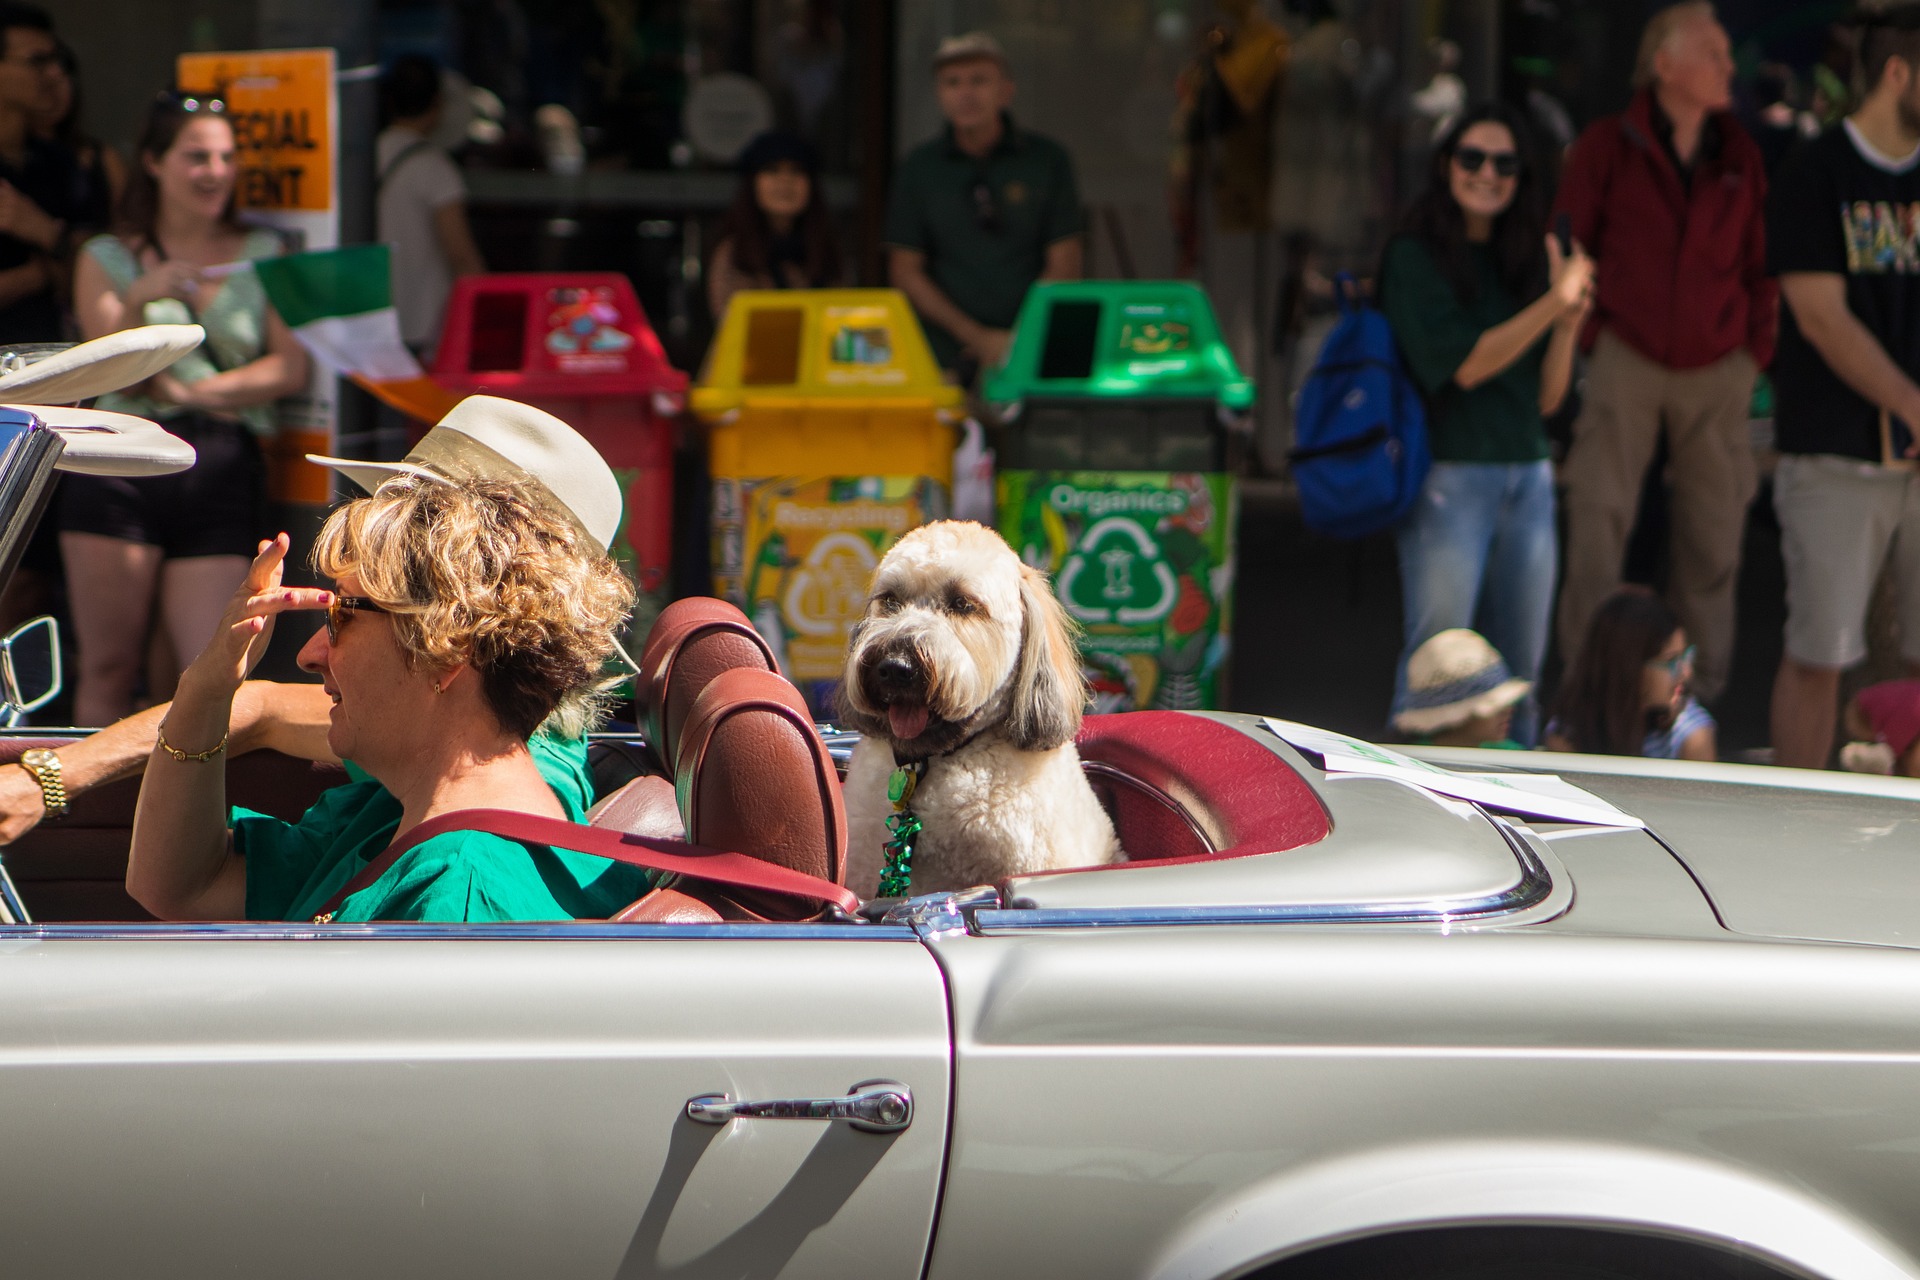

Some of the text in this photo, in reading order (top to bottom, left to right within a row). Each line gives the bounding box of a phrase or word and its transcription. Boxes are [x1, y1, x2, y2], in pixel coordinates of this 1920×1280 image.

[231, 109, 317, 150] ECIAL
[243, 166, 304, 207] ENT
[1050, 484, 1185, 517] Organics
